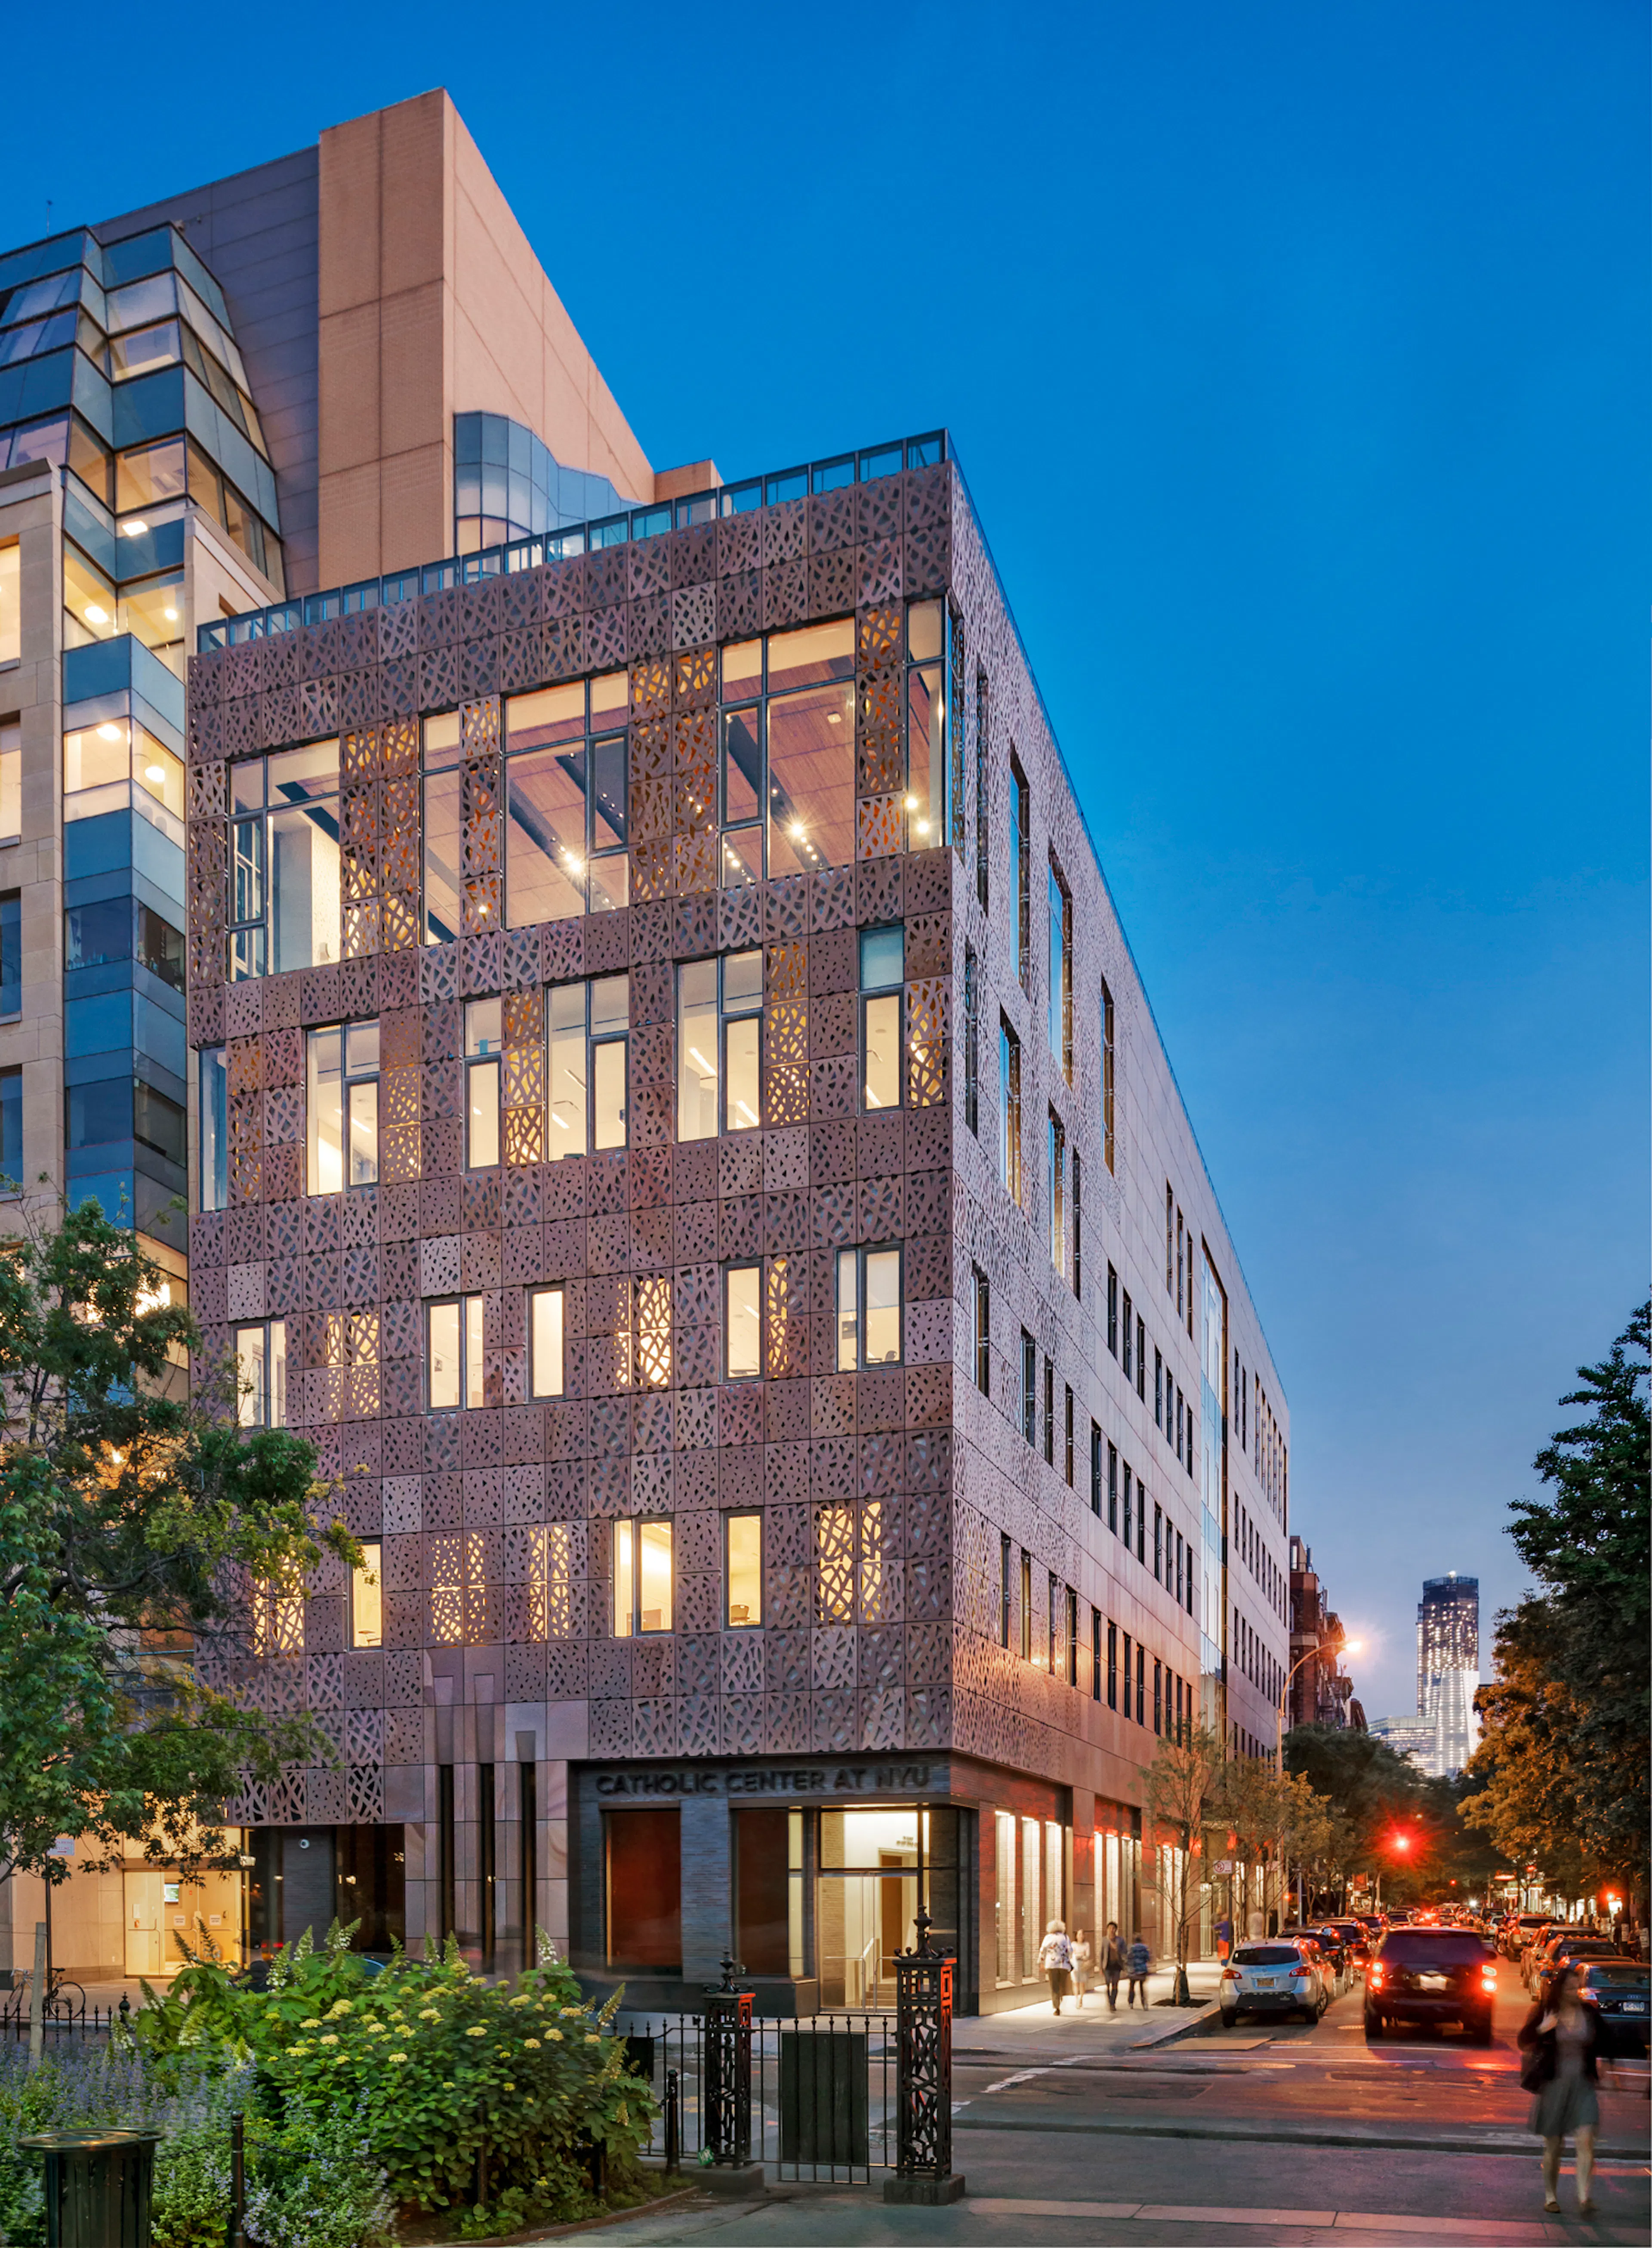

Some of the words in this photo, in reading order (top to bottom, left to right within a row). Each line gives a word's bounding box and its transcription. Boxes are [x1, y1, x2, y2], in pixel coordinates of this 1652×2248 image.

[596, 1773, 718, 1794] CATHOLIC
[726, 1769, 825, 1792] CENTER
[833, 1767, 866, 1789] AT
[877, 1766, 929, 1787] NYU
